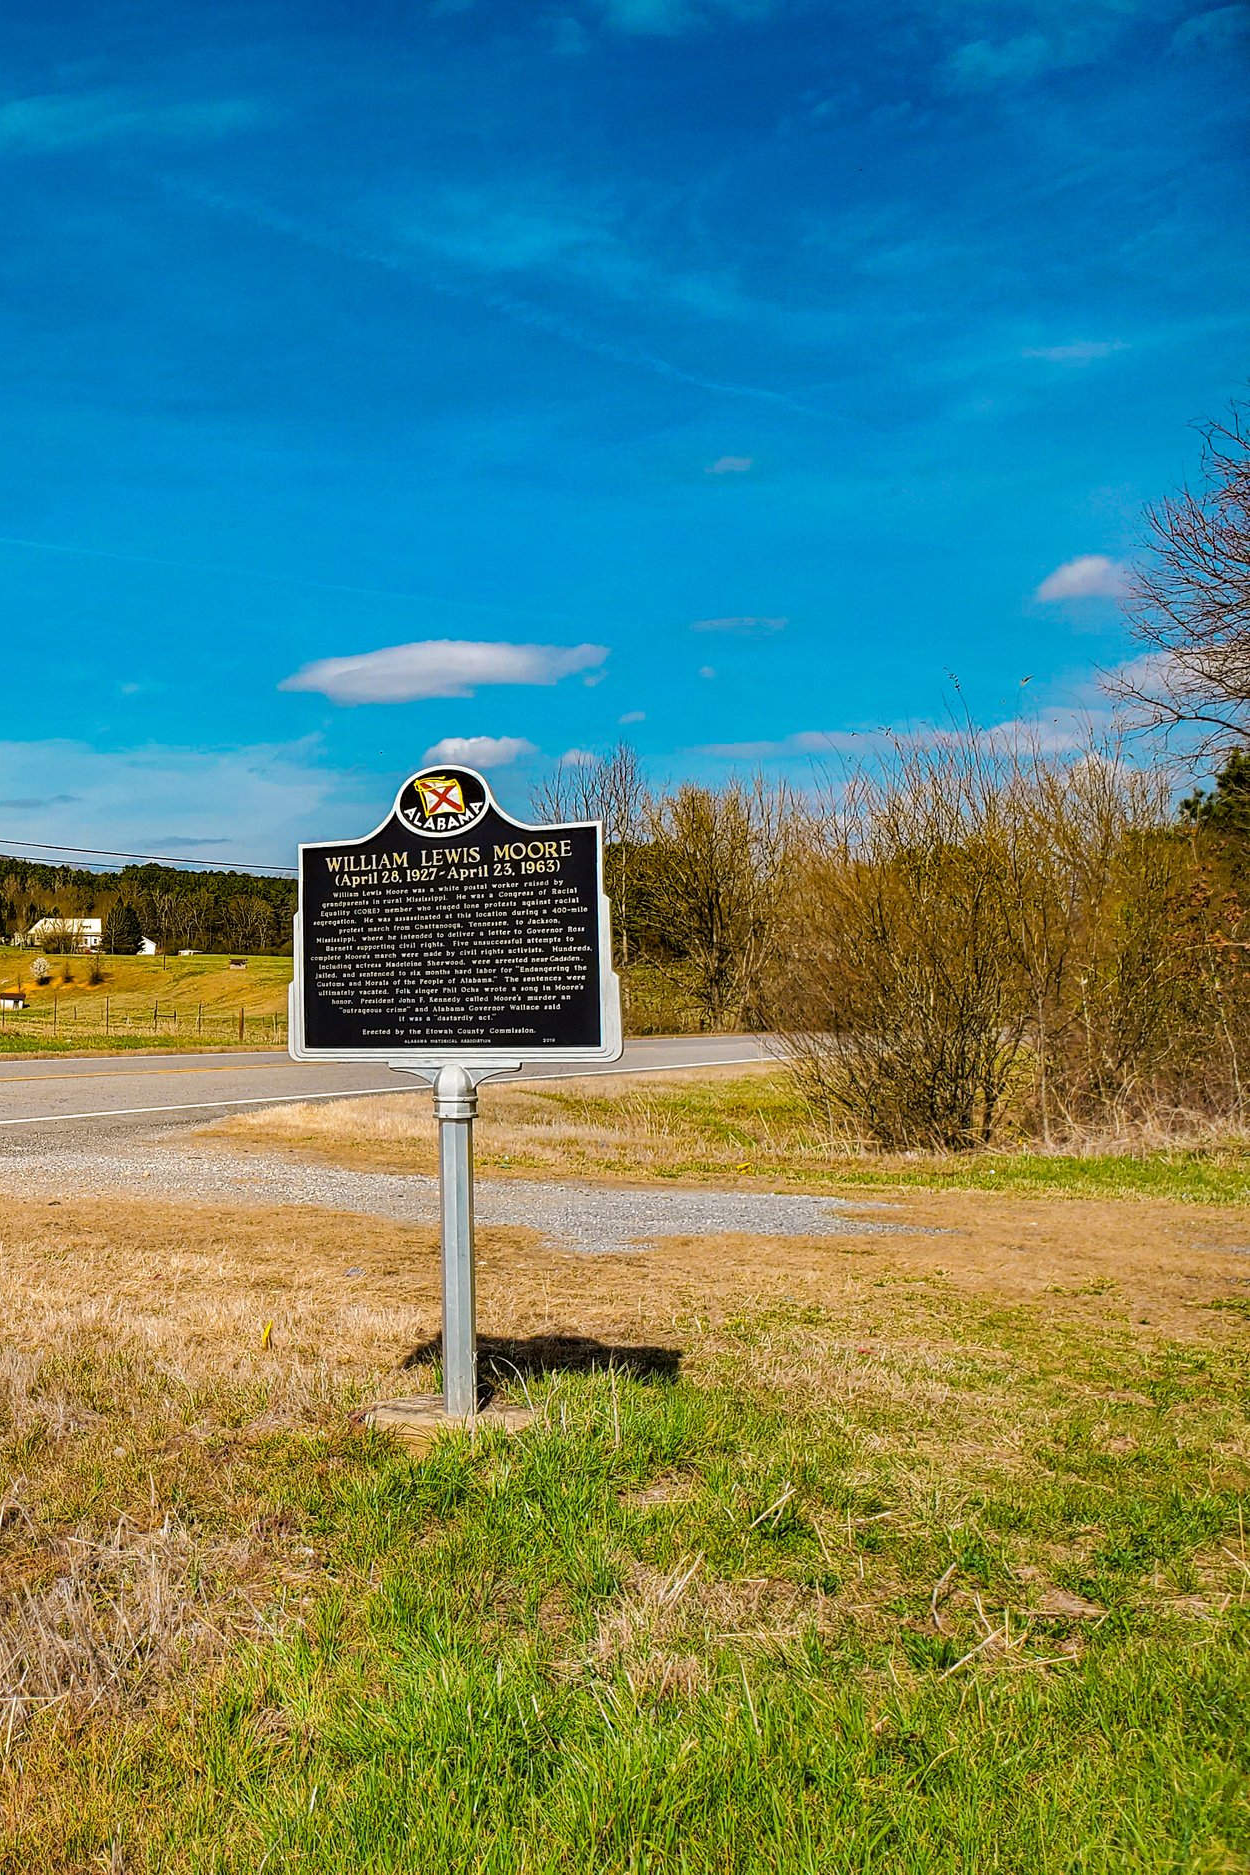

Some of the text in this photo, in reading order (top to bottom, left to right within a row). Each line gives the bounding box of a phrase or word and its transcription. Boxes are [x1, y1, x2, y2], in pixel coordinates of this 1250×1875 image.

[403, 801, 484, 831] ALABAMA
[325, 839, 572, 872] WILLIAM LEWIS MOORE
[335, 871, 378, 888] (April
[520, 859, 561, 875] 1963)
[362, 889, 382, 897] Lewis
[463, 883, 487, 892] postal
[524, 879, 549, 887] raised
[321, 899, 369, 909] grandparents
[538, 888, 547, 896] of
[551, 887, 577, 895] Racial
[320, 910, 350, 918] Equality
[354, 907, 380, 915] (CORE)
[435, 903, 460, 911] staged
[484, 900, 517, 909] protests
[522, 898, 551, 907] against
[554, 896, 579, 904] racial
[395, 913, 441, 922] assassinated
[475, 910, 507, 918] location
[511, 908, 539, 916] during
[552, 906, 588, 914] 400-mile
[338, 927, 364, 935] protest
[400, 932, 433, 940] intended
[526, 927, 563, 935] Governor
[357, 943, 395, 951] supporting
[473, 937, 523, 946] unsuccessful
[526, 936, 561, 944] attempts
[310, 954, 341, 962] complete
[480, 948, 504, 956] rights
[385, 960, 422, 968] Madeleine
[495, 956, 528, 964] arrested
[359, 970, 395, 978] sentenced
[419, 978, 444, 986] People
[395, 1028, 405, 1036] by
